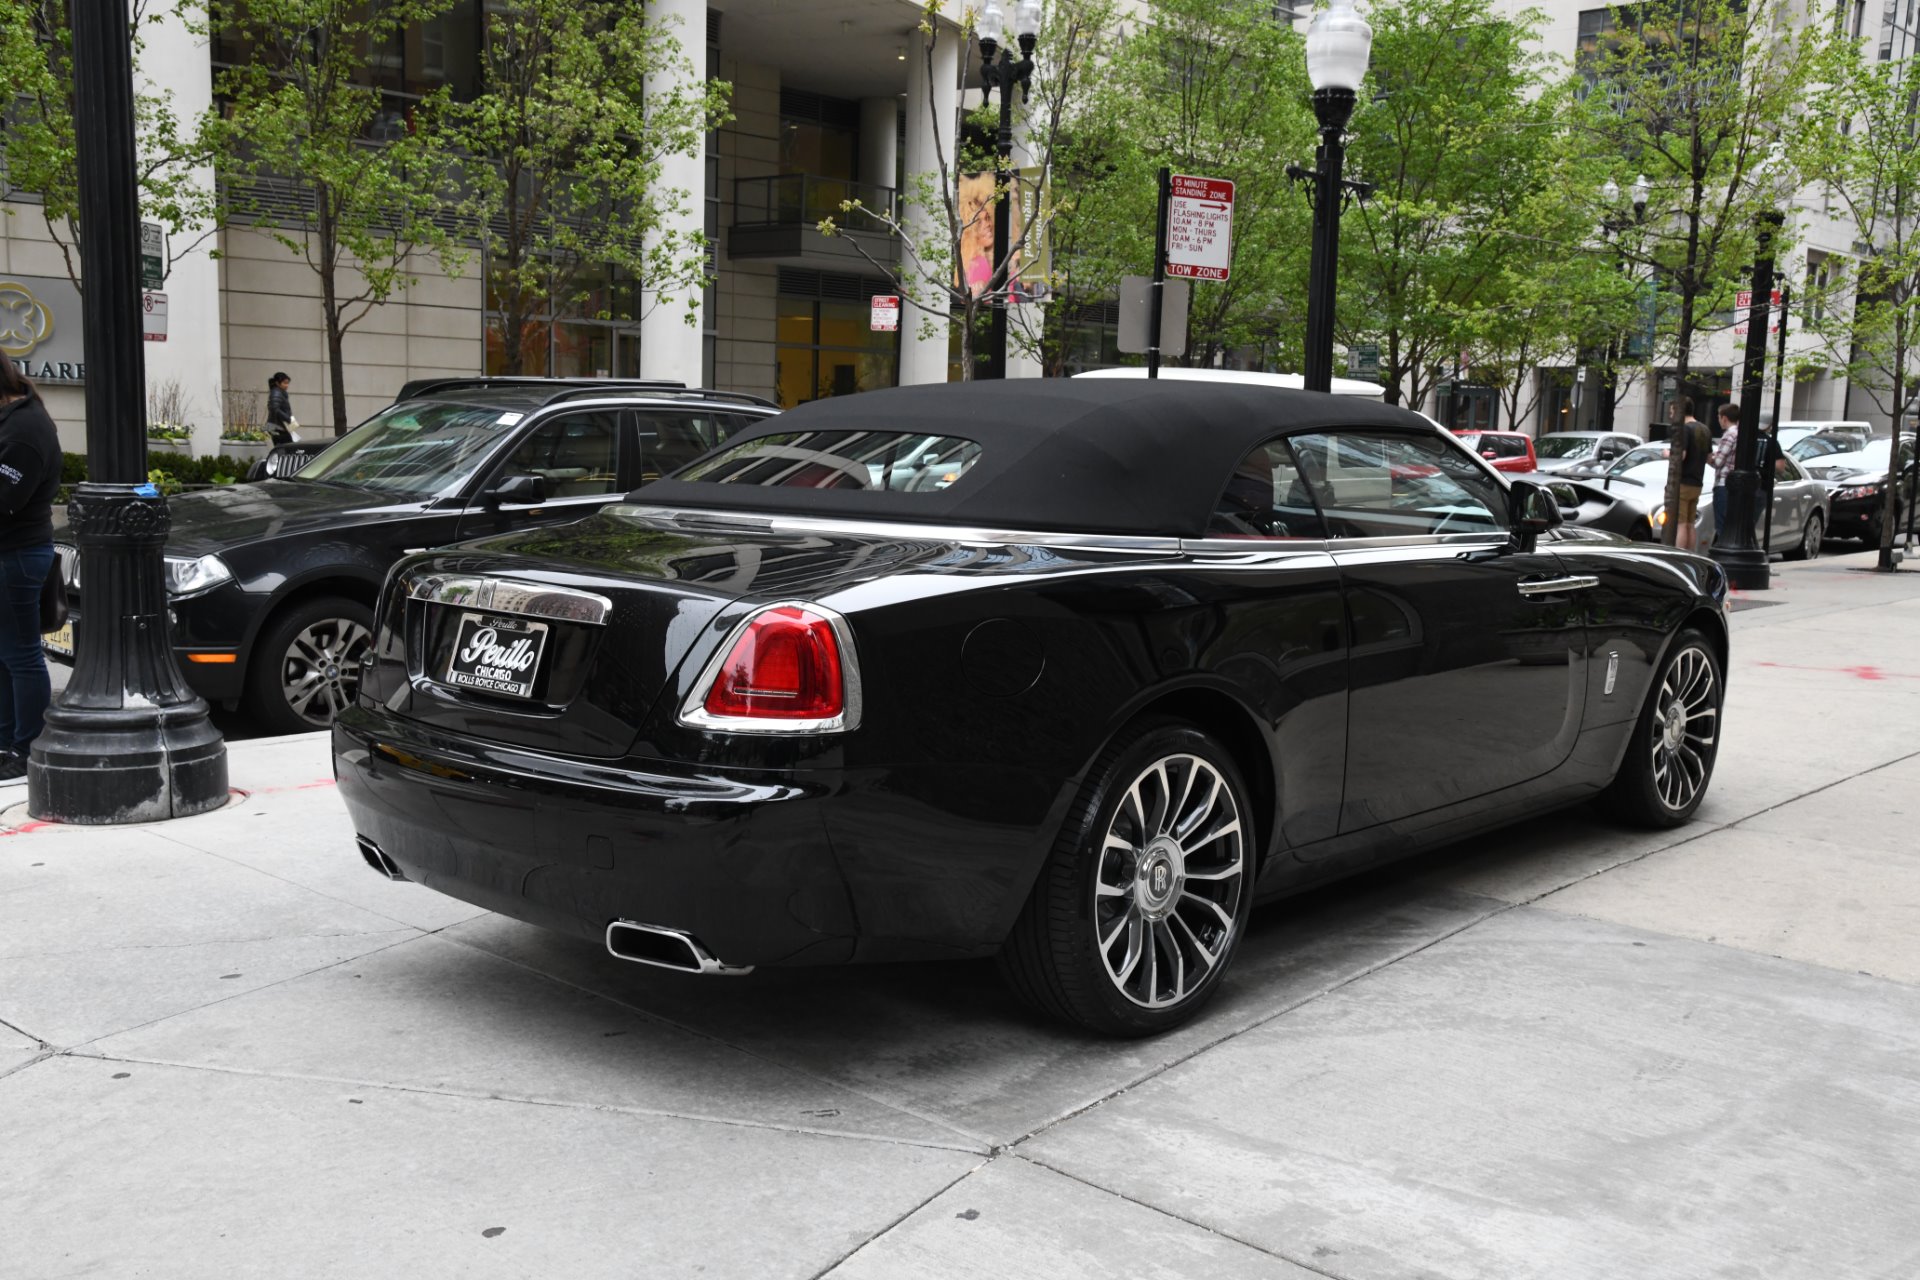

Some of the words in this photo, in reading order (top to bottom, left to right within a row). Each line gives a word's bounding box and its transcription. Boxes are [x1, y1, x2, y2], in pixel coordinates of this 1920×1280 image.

[1175, 178, 1182, 186] 15
[1183, 179, 1209, 190] MINUTE
[1175, 187, 1207, 198] STANDING
[1209, 191, 1227, 200] ZONE
[1174, 201, 1187, 209] USE
[1173, 209, 1206, 219] FLASHING
[1206, 212, 1229, 222] LIGHTS
[1172, 225, 1188, 233] MON
[1194, 228, 1217, 237] THURS
[1171, 242, 1183, 250] FRI
[1188, 244, 1203, 252] SUN
[1170, 264, 1192, 275] TOW
[1196, 267, 1223, 279] ZONE
[461, 628, 535, 672] Perillo
[475, 664, 512, 681] CHICAGO
[457, 674, 475, 685] ROLLS
[475, 677, 494, 689] ROYCE
[494, 680, 519, 693] CHICAGO
